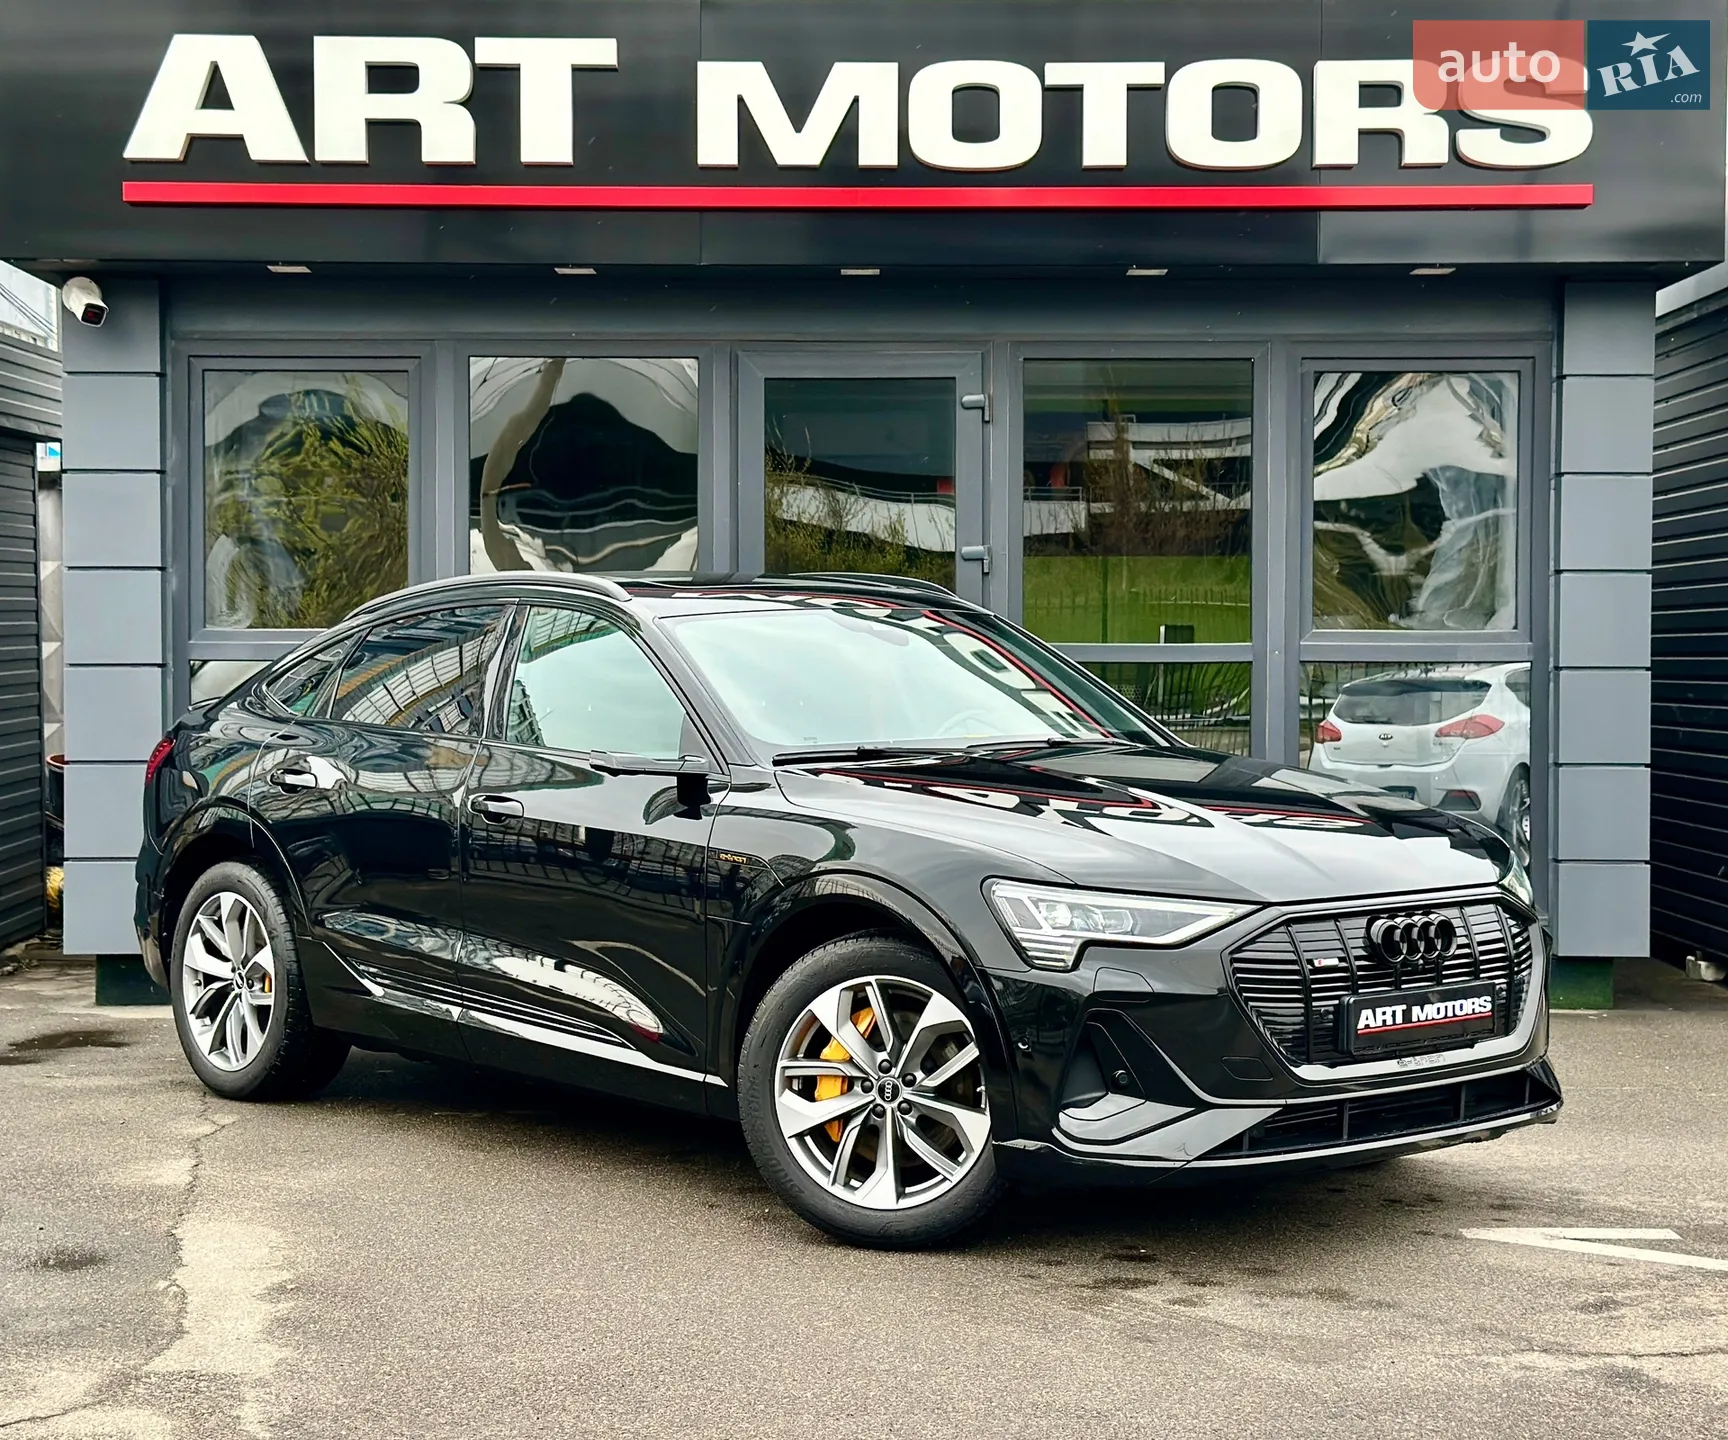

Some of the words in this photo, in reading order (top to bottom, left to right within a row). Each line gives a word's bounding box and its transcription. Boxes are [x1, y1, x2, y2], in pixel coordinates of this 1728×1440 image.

[122, 33, 618, 166] ART
[696, 57, 1594, 170] MOTORS
[1357, 1004, 1407, 1030] ART
[1411, 995, 1493, 1023] MOTORS
